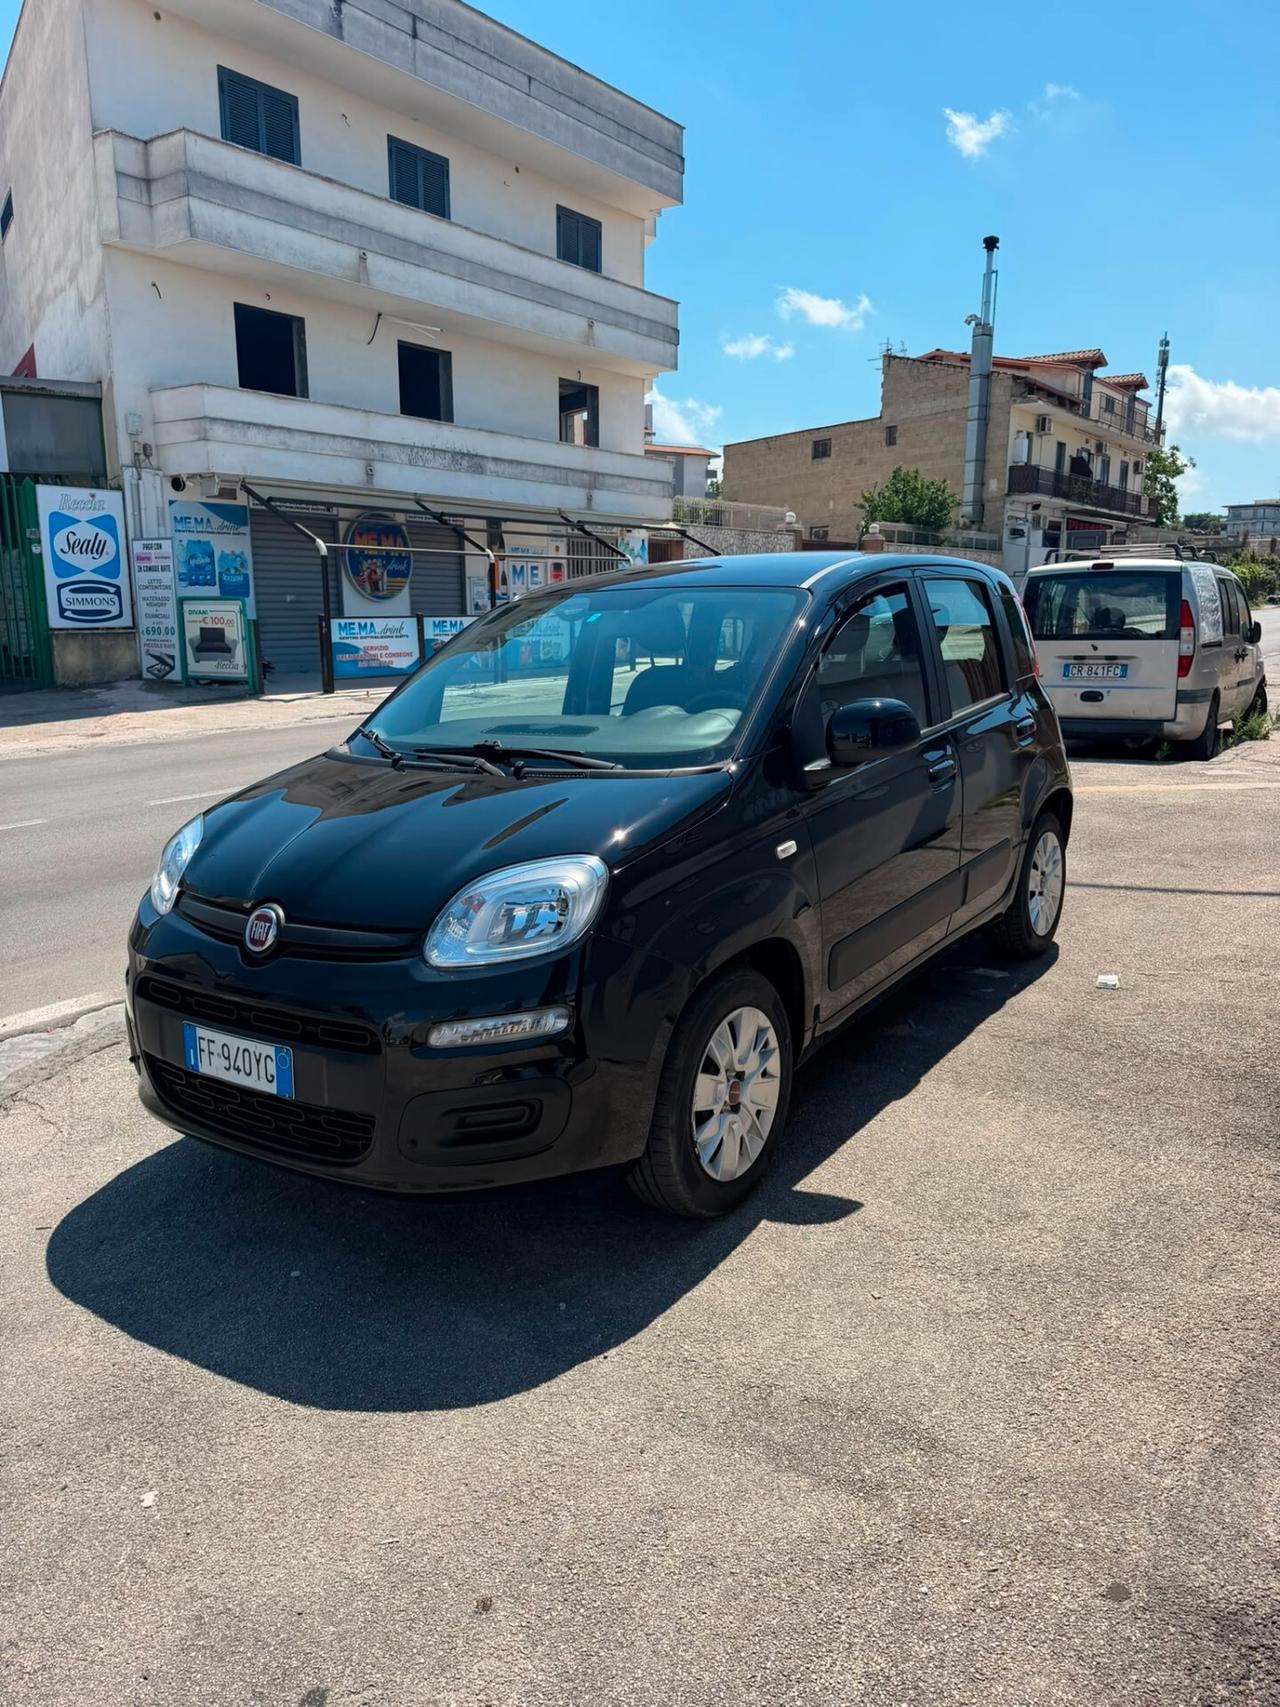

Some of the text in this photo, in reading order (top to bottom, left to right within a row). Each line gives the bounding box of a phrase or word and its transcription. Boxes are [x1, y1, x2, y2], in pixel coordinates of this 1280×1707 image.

[60, 531, 107, 560] Sealy
[65, 597, 116, 608] SIMMONS
[1070, 665, 1120, 676] CR 841FC
[250, 922, 272, 942] FIAT
